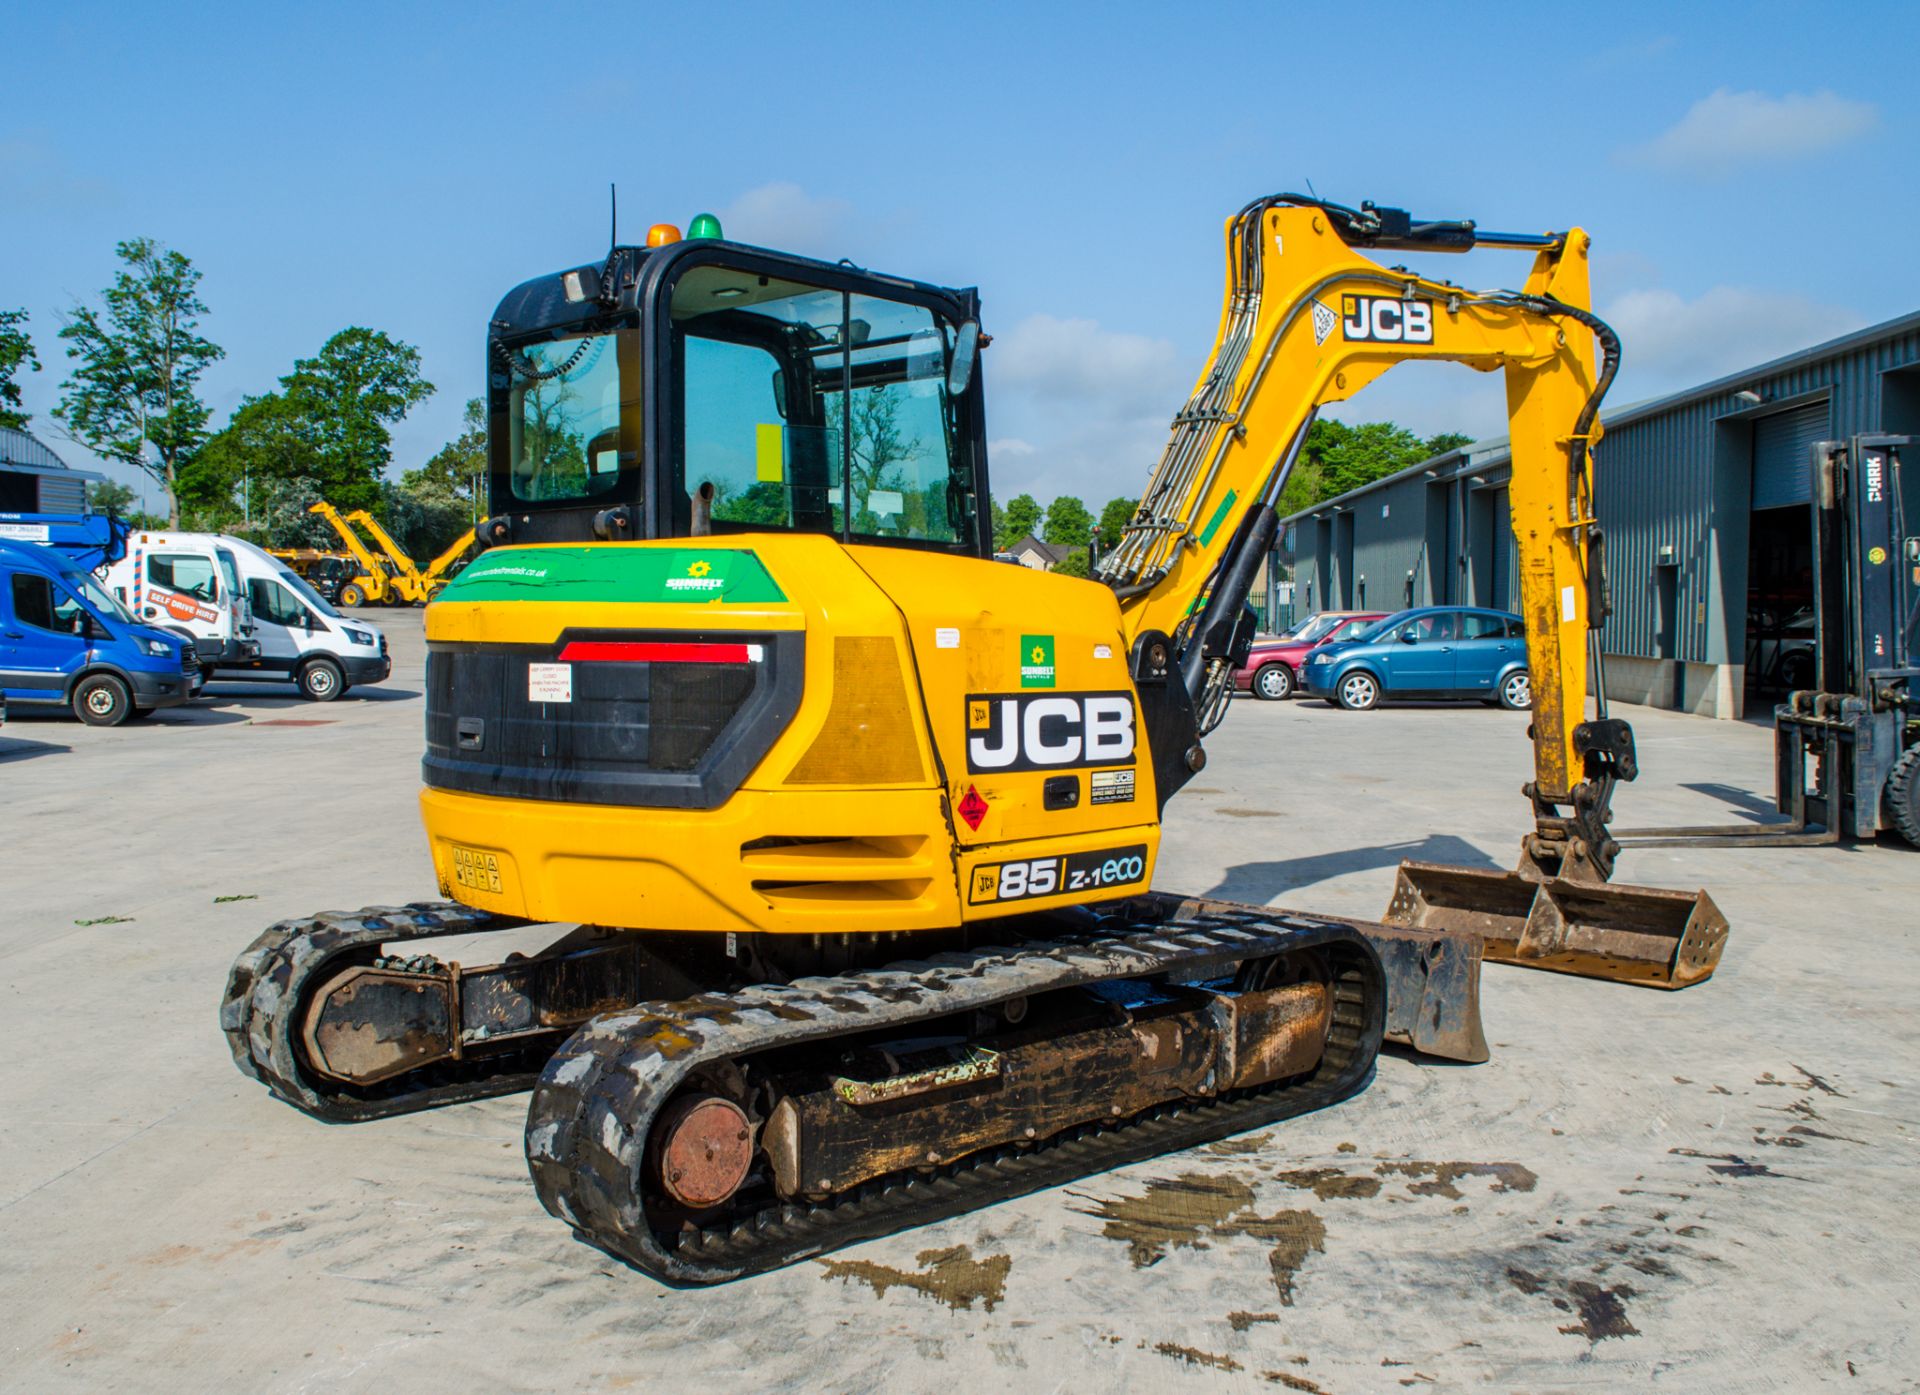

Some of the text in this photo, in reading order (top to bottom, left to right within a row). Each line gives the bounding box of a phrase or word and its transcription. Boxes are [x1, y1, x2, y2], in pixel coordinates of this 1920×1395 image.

[1345, 299, 1432, 341] JCB
[665, 578, 724, 588] SUNBELT
[151, 592, 216, 620] SELF DRIVE HIRE
[1021, 666, 1054, 675] SUNBELT
[970, 697, 1135, 767] JCB
[979, 875, 995, 892] JCB
[999, 859, 1057, 899] 85
